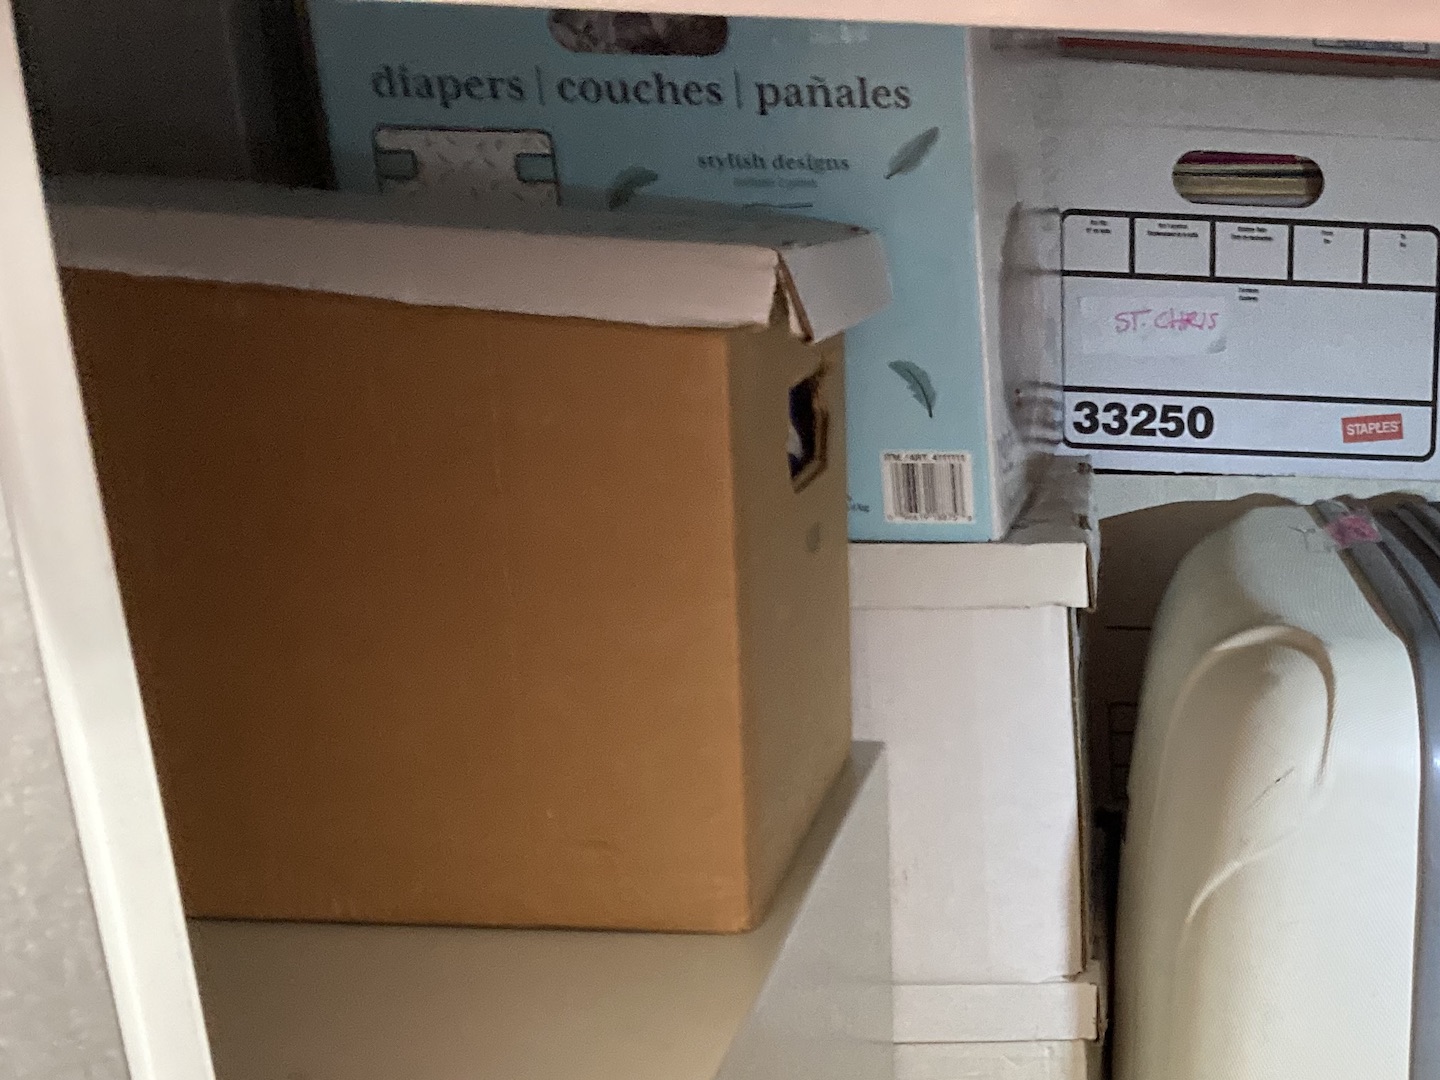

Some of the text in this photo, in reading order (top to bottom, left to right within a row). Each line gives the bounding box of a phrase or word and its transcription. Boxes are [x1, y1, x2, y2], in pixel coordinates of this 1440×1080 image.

[372, 64, 911, 115] diapers couches pañales
[698, 153, 849, 174] stylish designs
[1073, 401, 1214, 439] 33250
[1346, 421, 1399, 436] STAPLES
